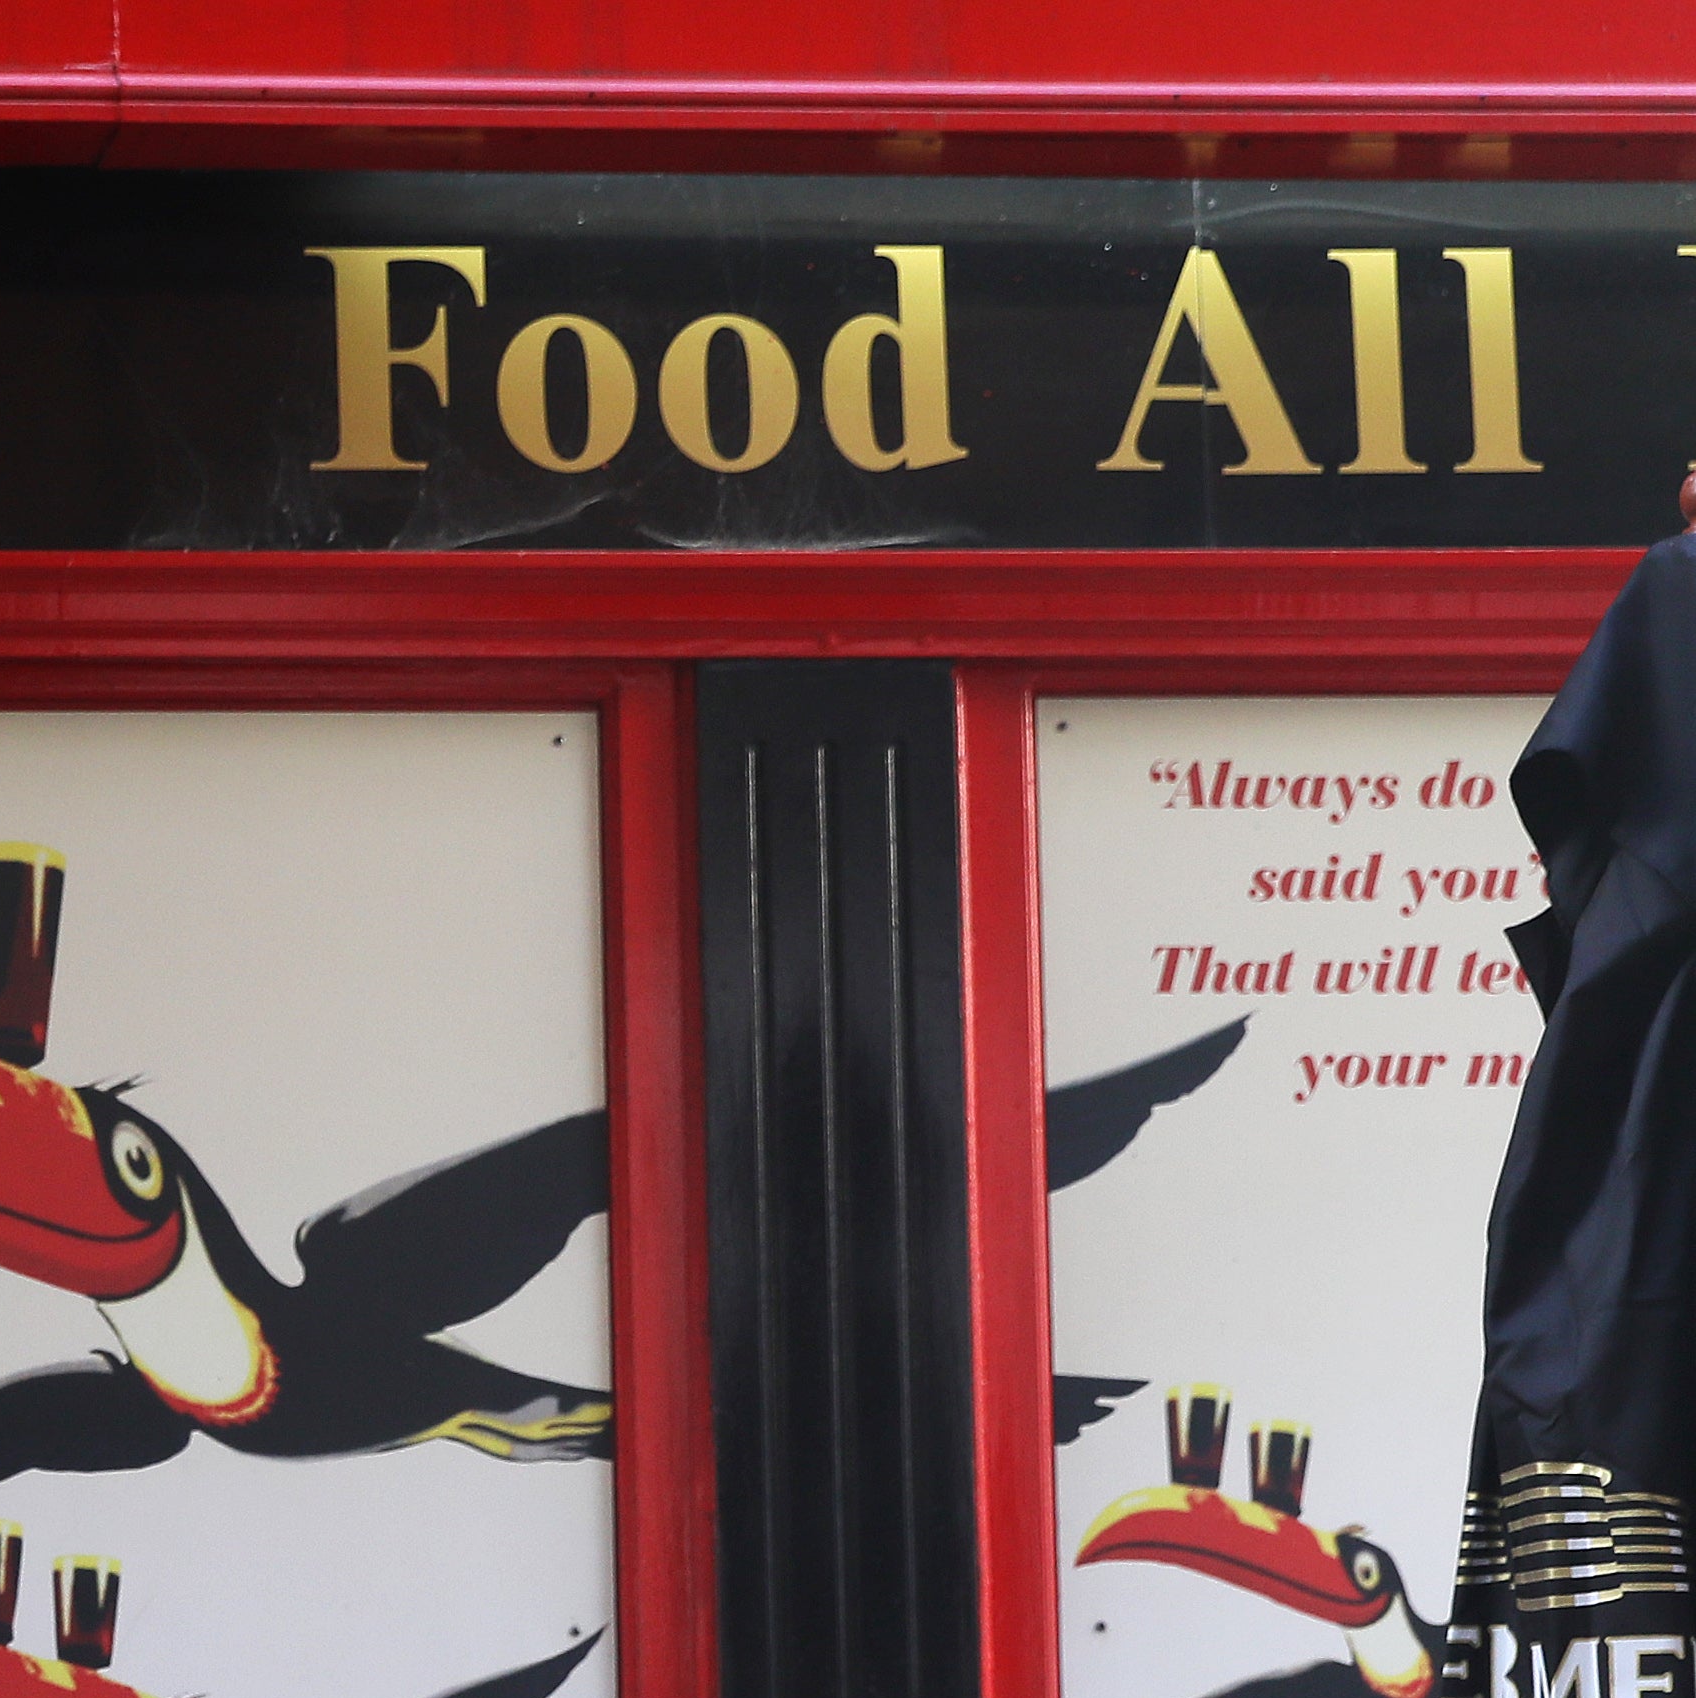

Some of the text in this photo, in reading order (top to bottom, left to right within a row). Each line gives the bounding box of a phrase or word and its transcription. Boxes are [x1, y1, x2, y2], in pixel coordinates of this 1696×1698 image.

[304, 244, 970, 474] Food
[1095, 245, 1545, 476] All
[1420, 760, 1496, 807] do
[1249, 853, 1383, 901] said
[1151, 944, 1295, 996] That
[1316, 946, 1439, 993] will
[1296, 1054, 1447, 1102] your
